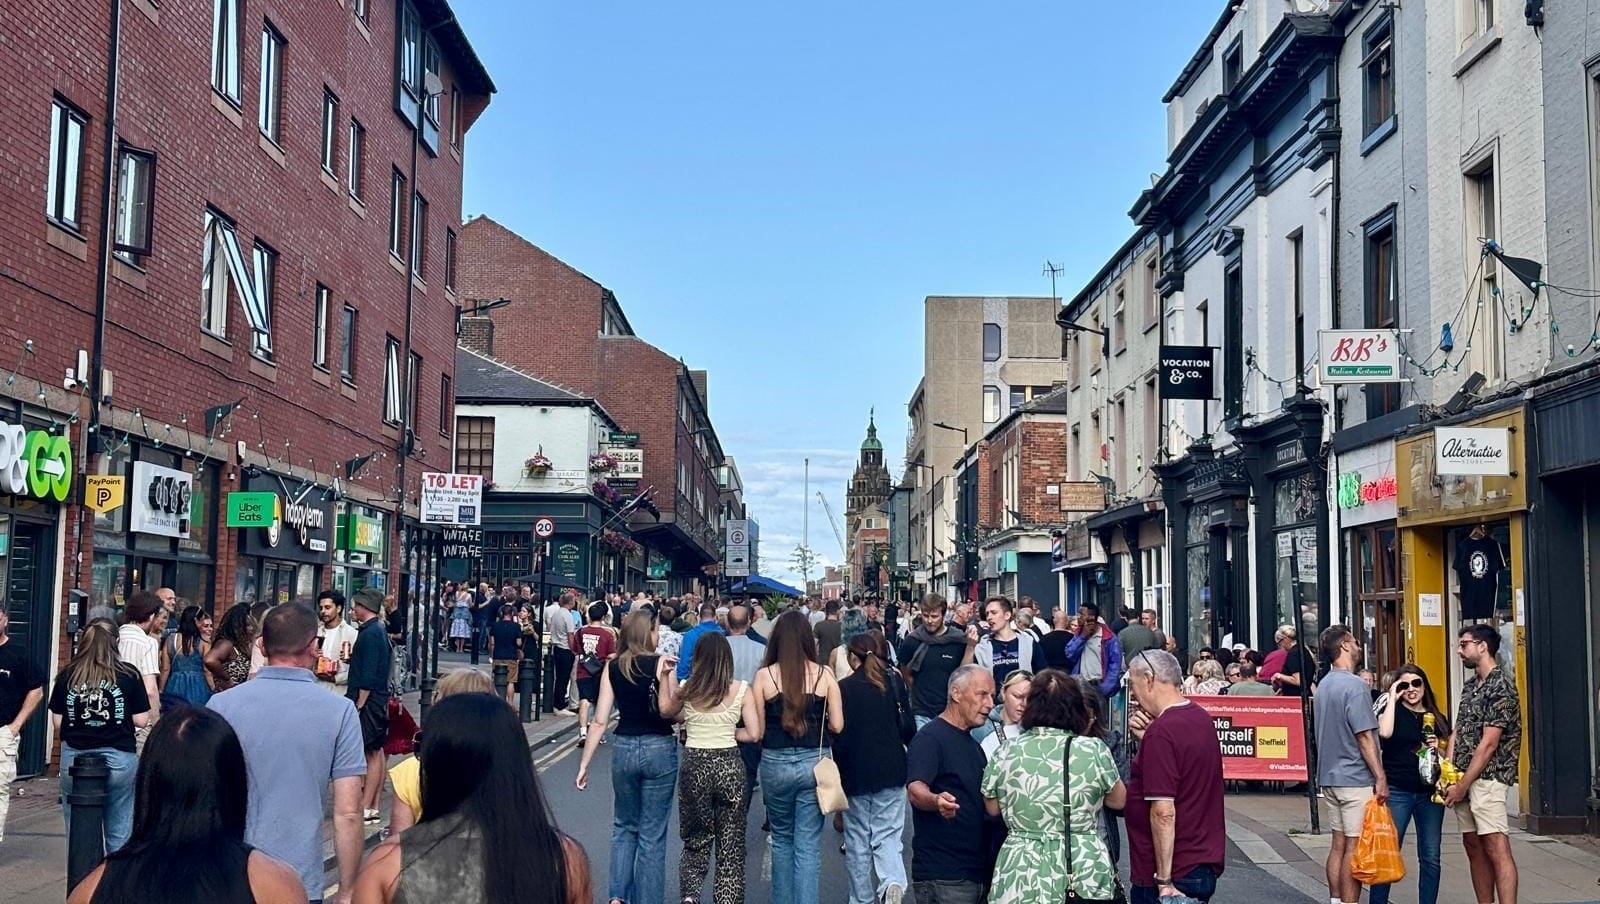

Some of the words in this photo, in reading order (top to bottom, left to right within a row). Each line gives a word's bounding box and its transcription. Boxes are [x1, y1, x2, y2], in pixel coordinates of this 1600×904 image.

[1162, 359, 1210, 367] VOCATION
[1355, 367, 1391, 375] Restaurant
[1169, 368, 1185, 385] &
[1441, 438, 1502, 458] Alternative
[88, 478, 121, 486] PayPoint
[427, 474, 447, 488] TO
[451, 475, 478, 490] LET
[239, 502, 262, 511] Uber
[239, 513, 262, 521] Eats
[537, 523, 552, 532] 20
[442, 529, 482, 542] VINTAGE
[442, 544, 482, 559] VINTAGE
[1258, 738, 1286, 746] Sheffield
